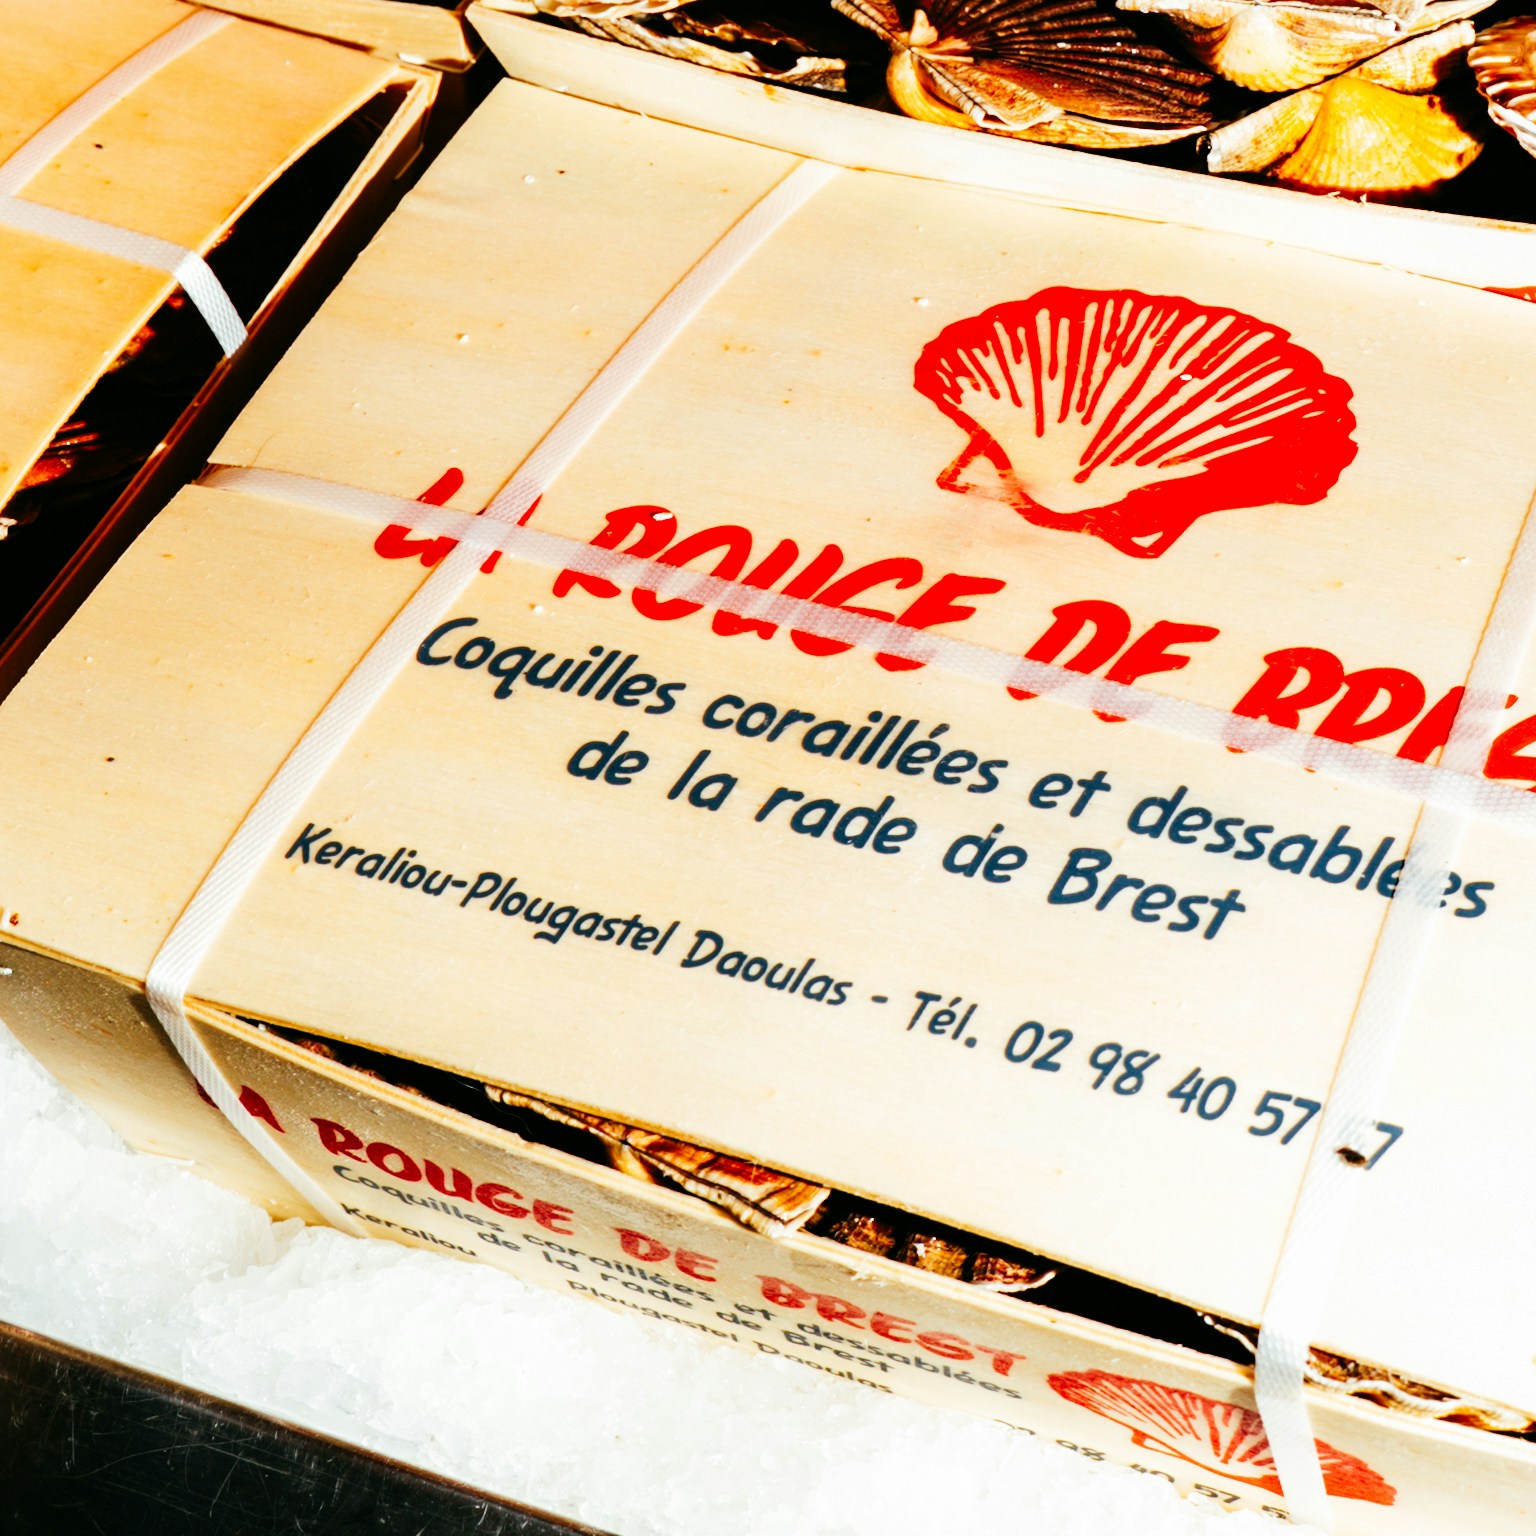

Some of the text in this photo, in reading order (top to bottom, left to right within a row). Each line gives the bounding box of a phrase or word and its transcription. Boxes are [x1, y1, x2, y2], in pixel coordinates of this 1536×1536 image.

[552, 504, 1007, 673] ROUGE
[415, 616, 687, 716] Coquilles
[700, 692, 1010, 795] coraillées
[1028, 769, 1113, 819] et
[565, 729, 1247, 941] de la rade de Brest
[285, 821, 682, 956] Keraliou-Plougastel
[680, 929, 854, 1007] Daoulas
[905, 989, 980, 1049] Tél.
[1003, 1020, 1074, 1074] 02
[1087, 1041, 1161, 1097] 98
[1167, 1066, 1238, 1122] 40
[1248, 1089, 1322, 1146] 57
[309, 1117, 575, 1236] ROUGE
[611, 1226, 721, 1283] DE
[755, 1274, 1028, 1378] BREST
[332, 1164, 1024, 1401] Coquilles coraillées et dessablées
[477, 1230, 896, 1374] de la rade de Brest
[1194, 1482, 1242, 1505] 57
